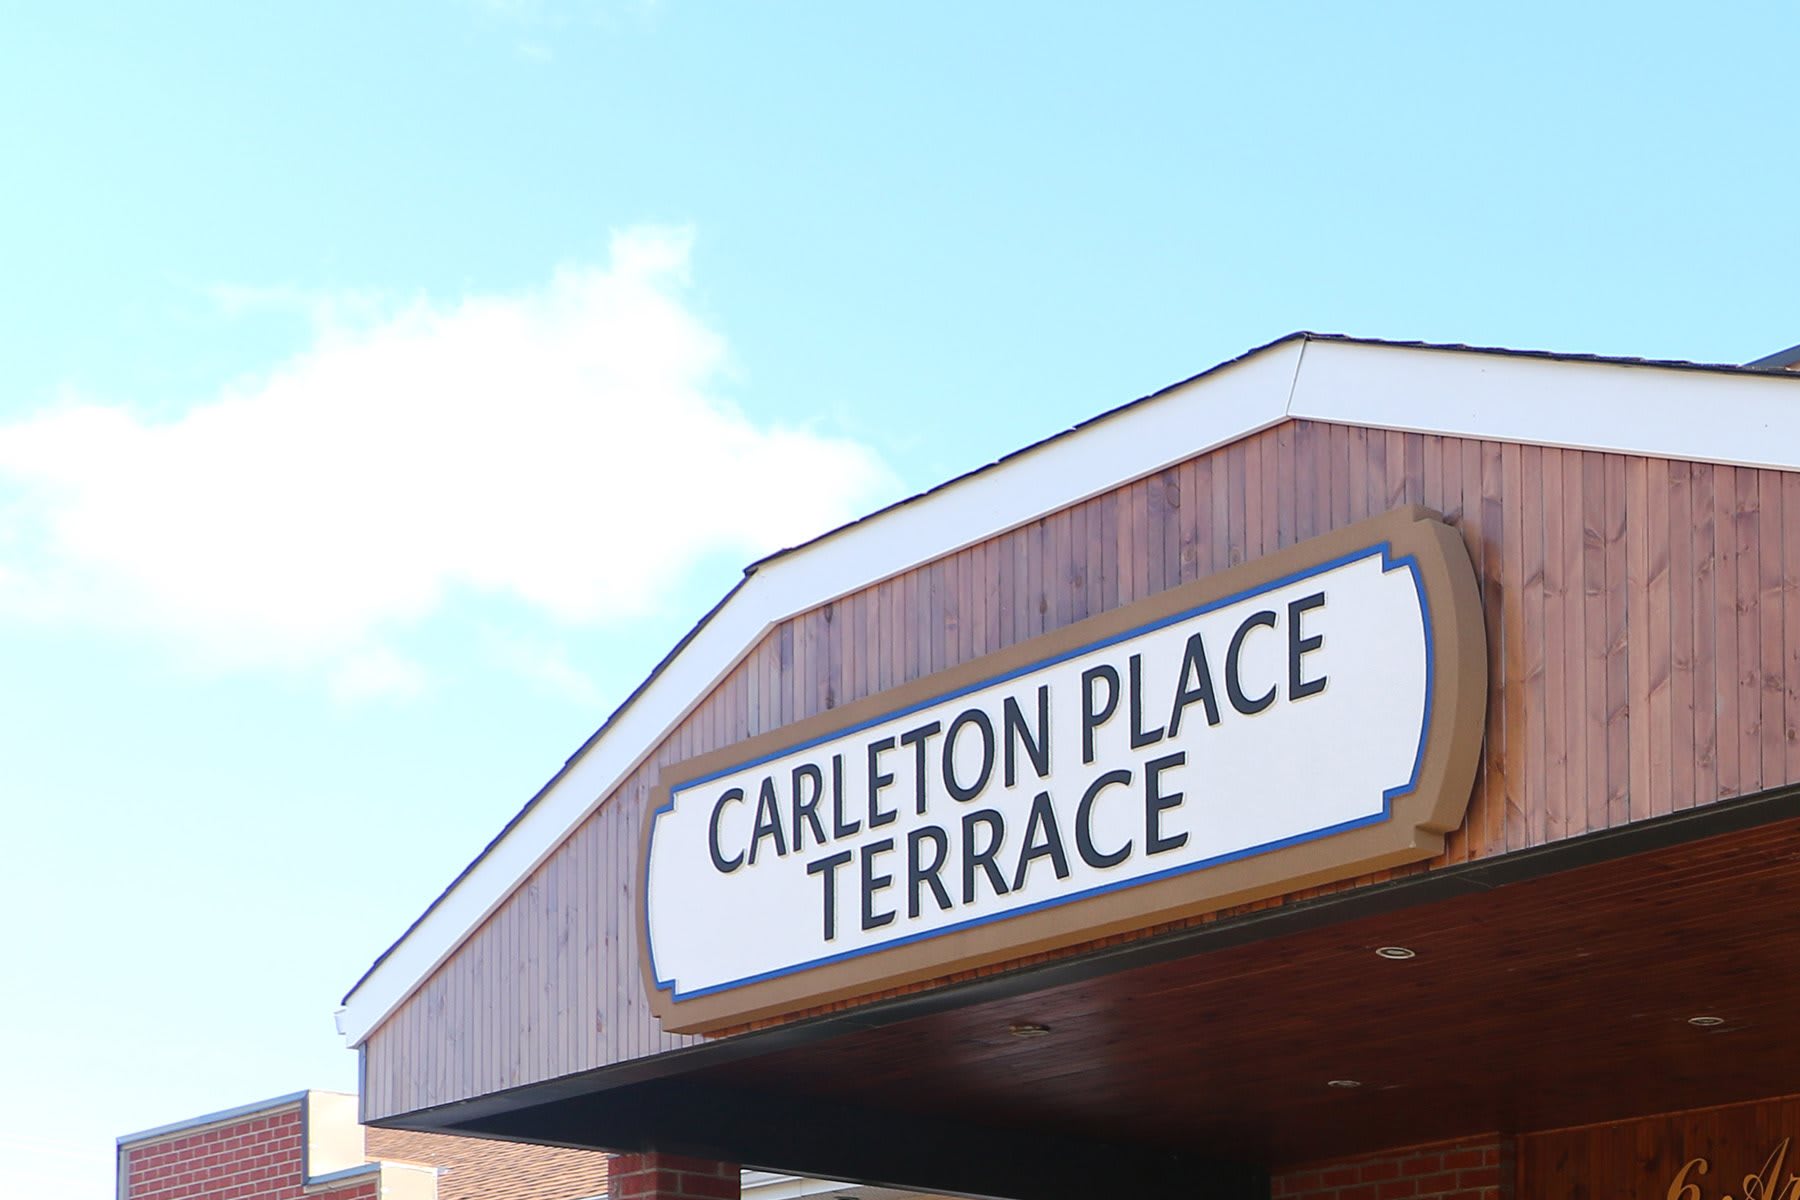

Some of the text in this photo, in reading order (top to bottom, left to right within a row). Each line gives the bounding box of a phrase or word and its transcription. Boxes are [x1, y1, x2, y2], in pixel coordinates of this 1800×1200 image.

[707, 590, 1328, 874] CARLETON PLACE
[806, 751, 1189, 942] TERRACE
